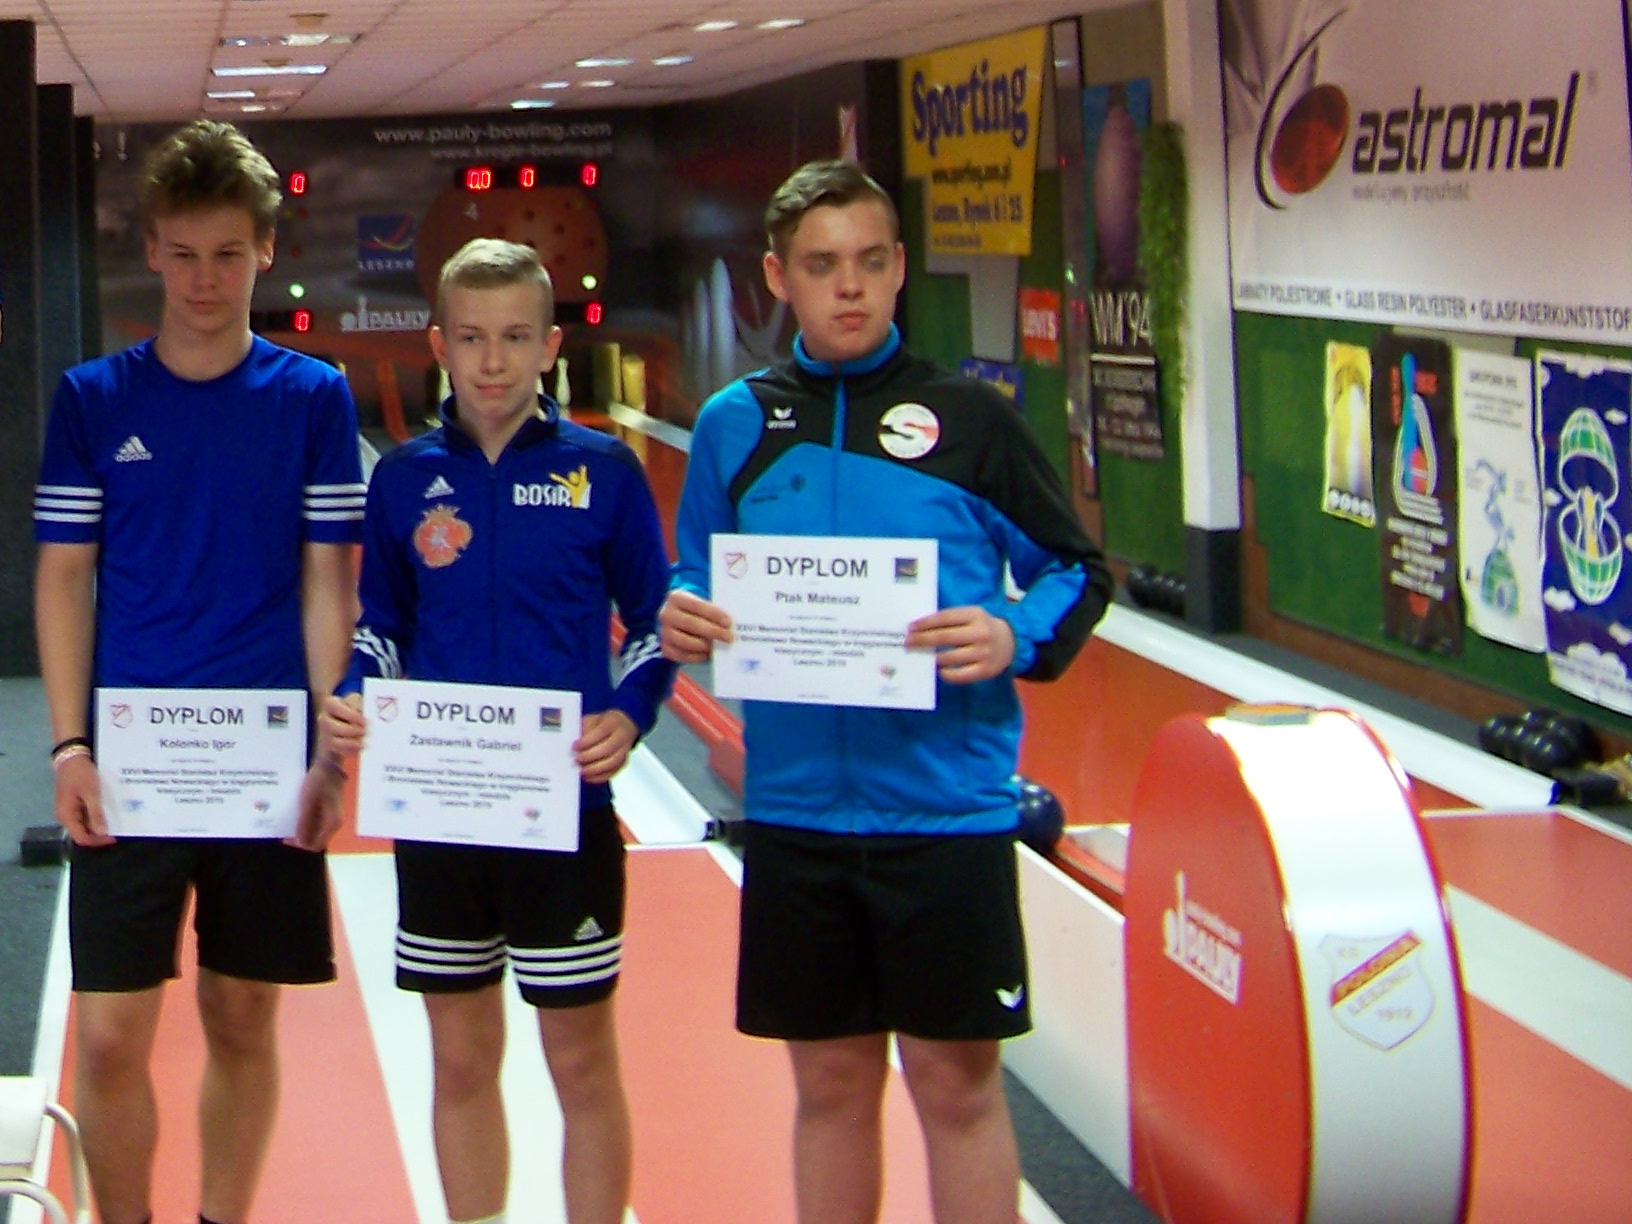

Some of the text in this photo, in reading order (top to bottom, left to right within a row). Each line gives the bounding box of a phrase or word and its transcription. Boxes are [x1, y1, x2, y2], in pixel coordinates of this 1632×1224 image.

[911, 59, 1028, 157] Sporting
[1352, 71, 1581, 173] astromal
[374, 124, 611, 145] www.pauly-bowling.com
[1408, 293, 1468, 318] POLYESTER
[369, 310, 431, 329] PAULY
[767, 556, 869, 579] DYPLOM
[150, 706, 244, 726] DYPLOM
[417, 701, 516, 726] DYPLOM
